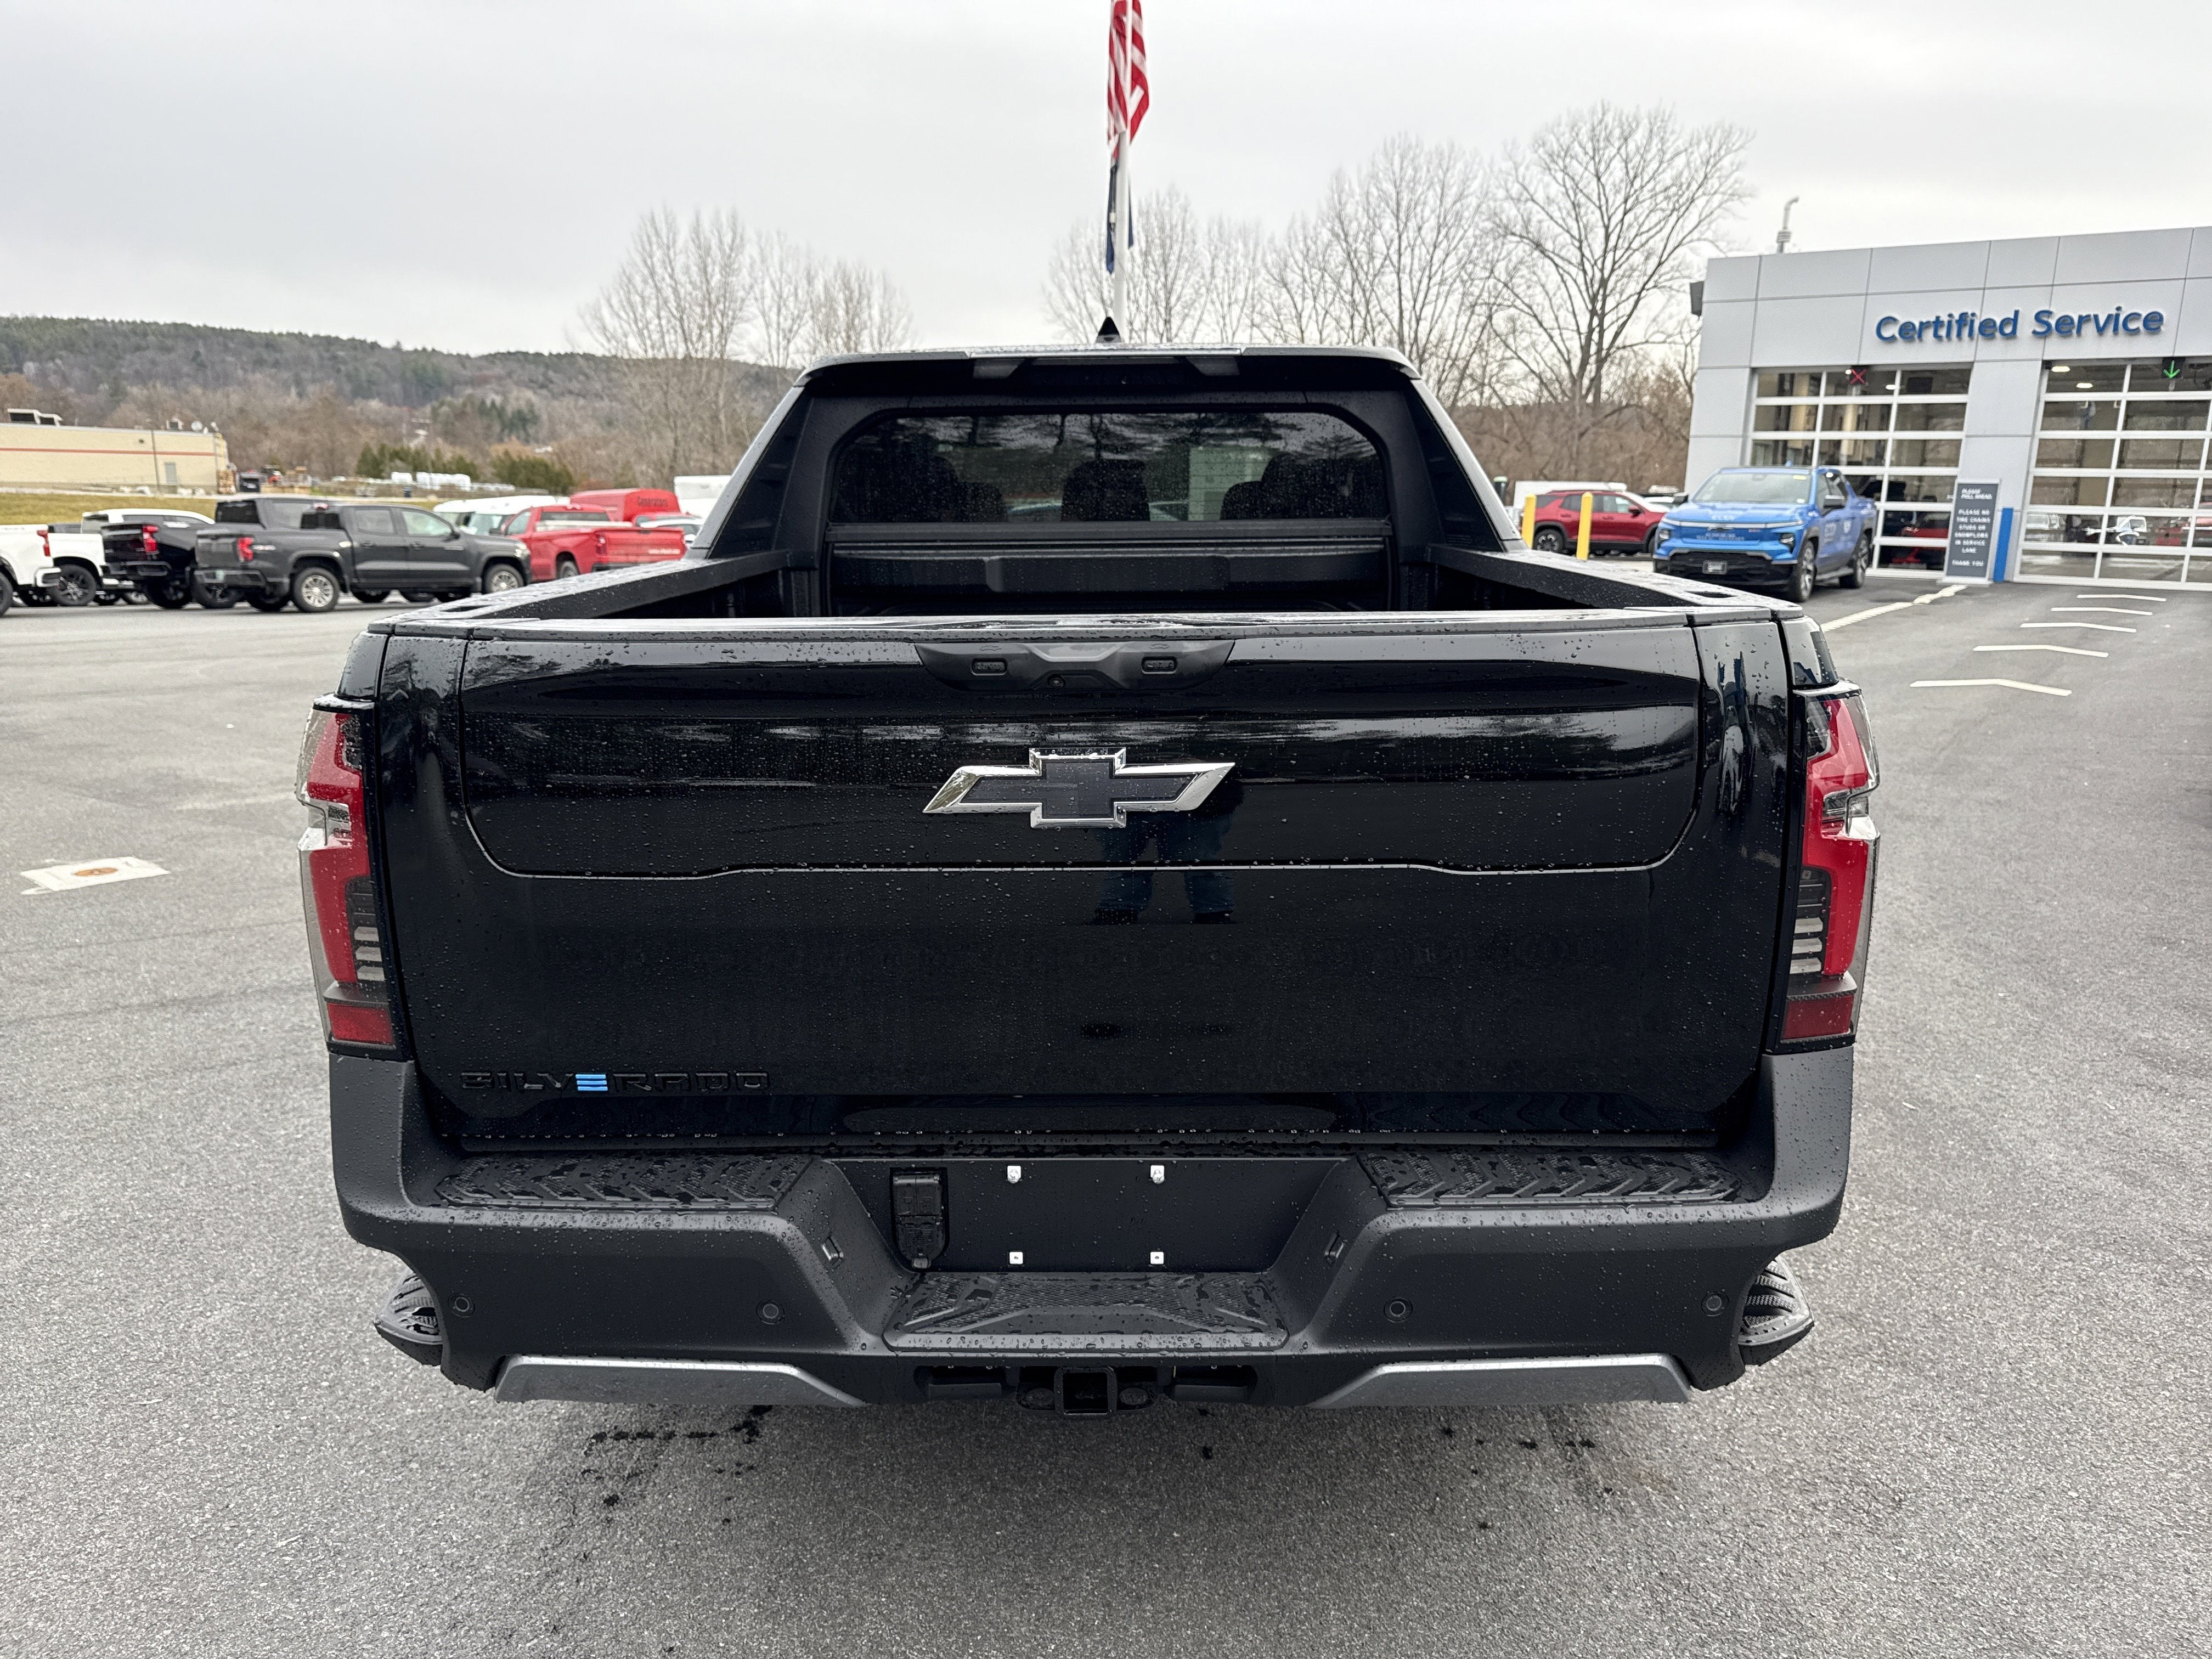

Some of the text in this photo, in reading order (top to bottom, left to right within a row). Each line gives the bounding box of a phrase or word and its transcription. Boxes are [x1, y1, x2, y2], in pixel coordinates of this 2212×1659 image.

[1875, 305, 2164, 342] Certified Service
[460, 1071, 771, 1093] SILVERADO
